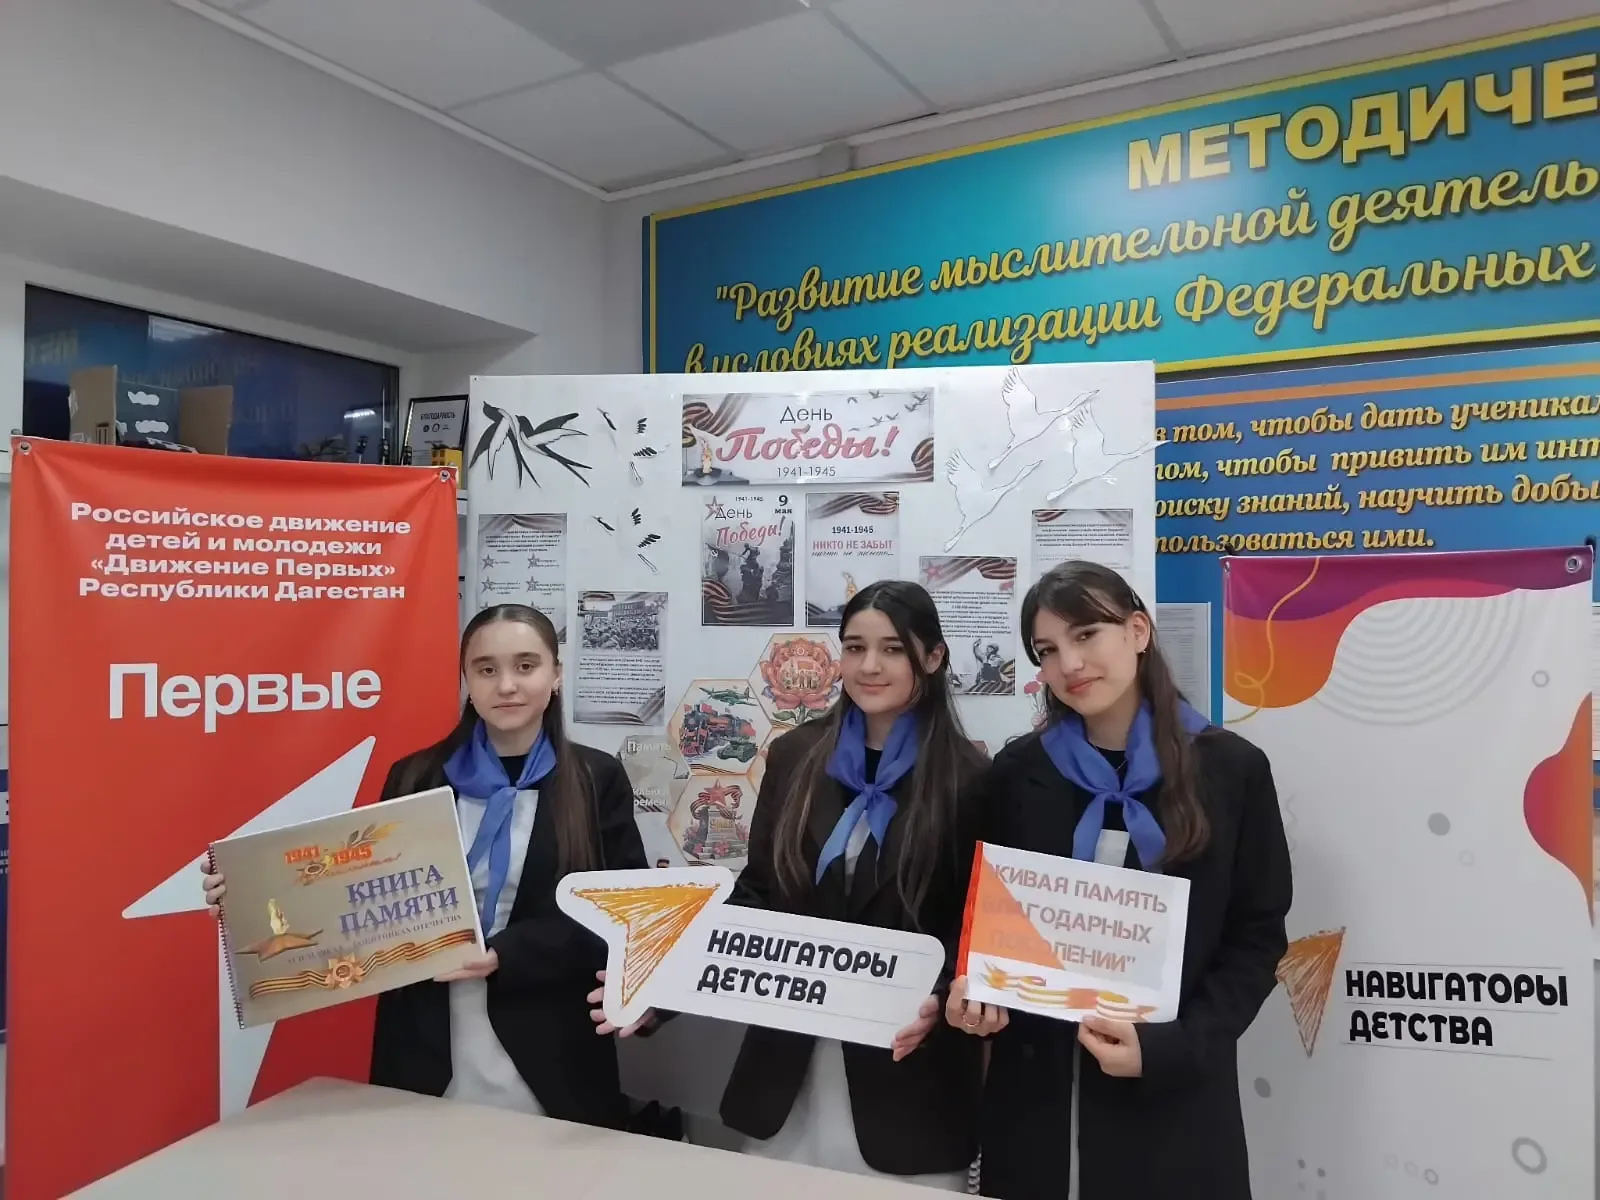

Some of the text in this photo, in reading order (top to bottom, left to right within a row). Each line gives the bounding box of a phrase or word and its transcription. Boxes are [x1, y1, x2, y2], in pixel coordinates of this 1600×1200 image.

[1128, 54, 1598, 190] МЕТОДИЧЕ
[716, 160, 1599, 331] "Развитие мыслительной деятель
[887, 296, 1161, 368] реализации
[1174, 241, 1596, 336] Федеральных
[780, 405, 833, 424] День
[1173, 421, 1243, 444] том,
[1251, 406, 1353, 437] чтобы
[1360, 402, 1443, 430] дать
[1450, 394, 1600, 431] ученика
[715, 423, 900, 462] Победы!
[1216, 448, 1317, 477] чтобы
[1331, 445, 1472, 477] привить
[1480, 441, 1527, 463] им
[776, 465, 836, 478] 1941-1945
[714, 506, 753, 519] День
[778, 494, 788, 507] 9
[1237, 483, 1350, 515] знаний,
[1358, 484, 1503, 514] научить
[71, 502, 411, 534] Российское движение
[715, 515, 786, 547] Победы!
[831, 525, 874, 534] 1941-1945
[105, 531, 382, 556] детей и молодежи
[812, 539, 892, 551] НИКТО НЕ ЗАБЫТ
[1361, 528, 1435, 548] ими.
[91, 554, 395, 580] «Движение Первых»
[79, 577, 406, 602] Республики Дагестан
[109, 663, 382, 733] Первые
[345, 863, 444, 904] КНИГА
[1074, 879, 1168, 914] ПАМЯТЬ
[338, 886, 460, 934] ПАМЯТИ
[706, 928, 898, 979] НАВИГАТОРЫ
[696, 963, 828, 1005] ДЕТСТВА
[1345, 970, 1569, 1006] НАВИГАТОРЫ
[1349, 1009, 1494, 1047] ДЕТСТВА
